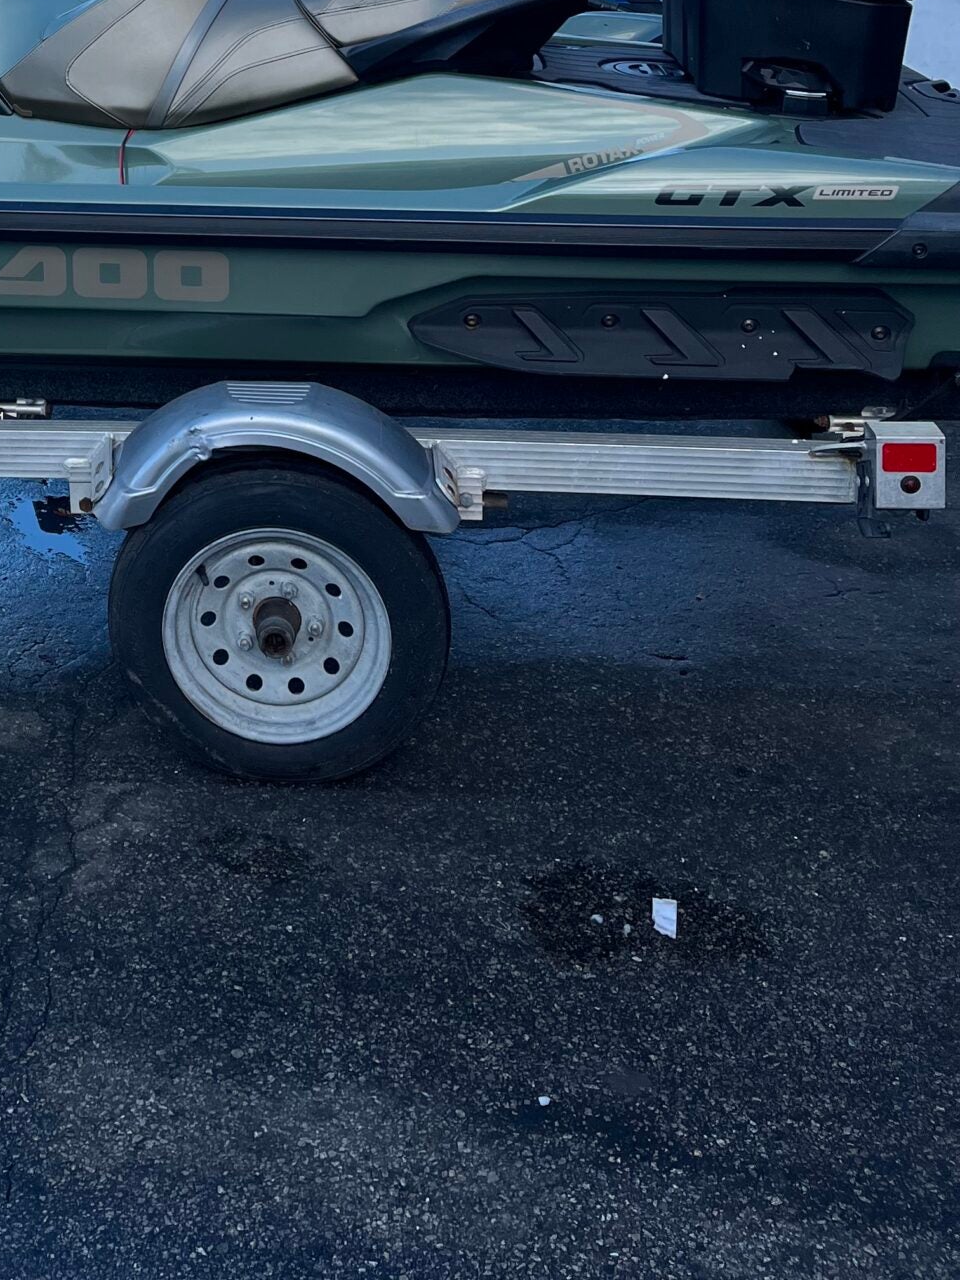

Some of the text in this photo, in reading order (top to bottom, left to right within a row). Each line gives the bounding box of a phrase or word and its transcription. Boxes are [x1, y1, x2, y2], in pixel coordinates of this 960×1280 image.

[570, 144, 644, 174] ROTAX
[654, 184, 814, 207] GTX
[817, 187, 895, 198] LIMITED
